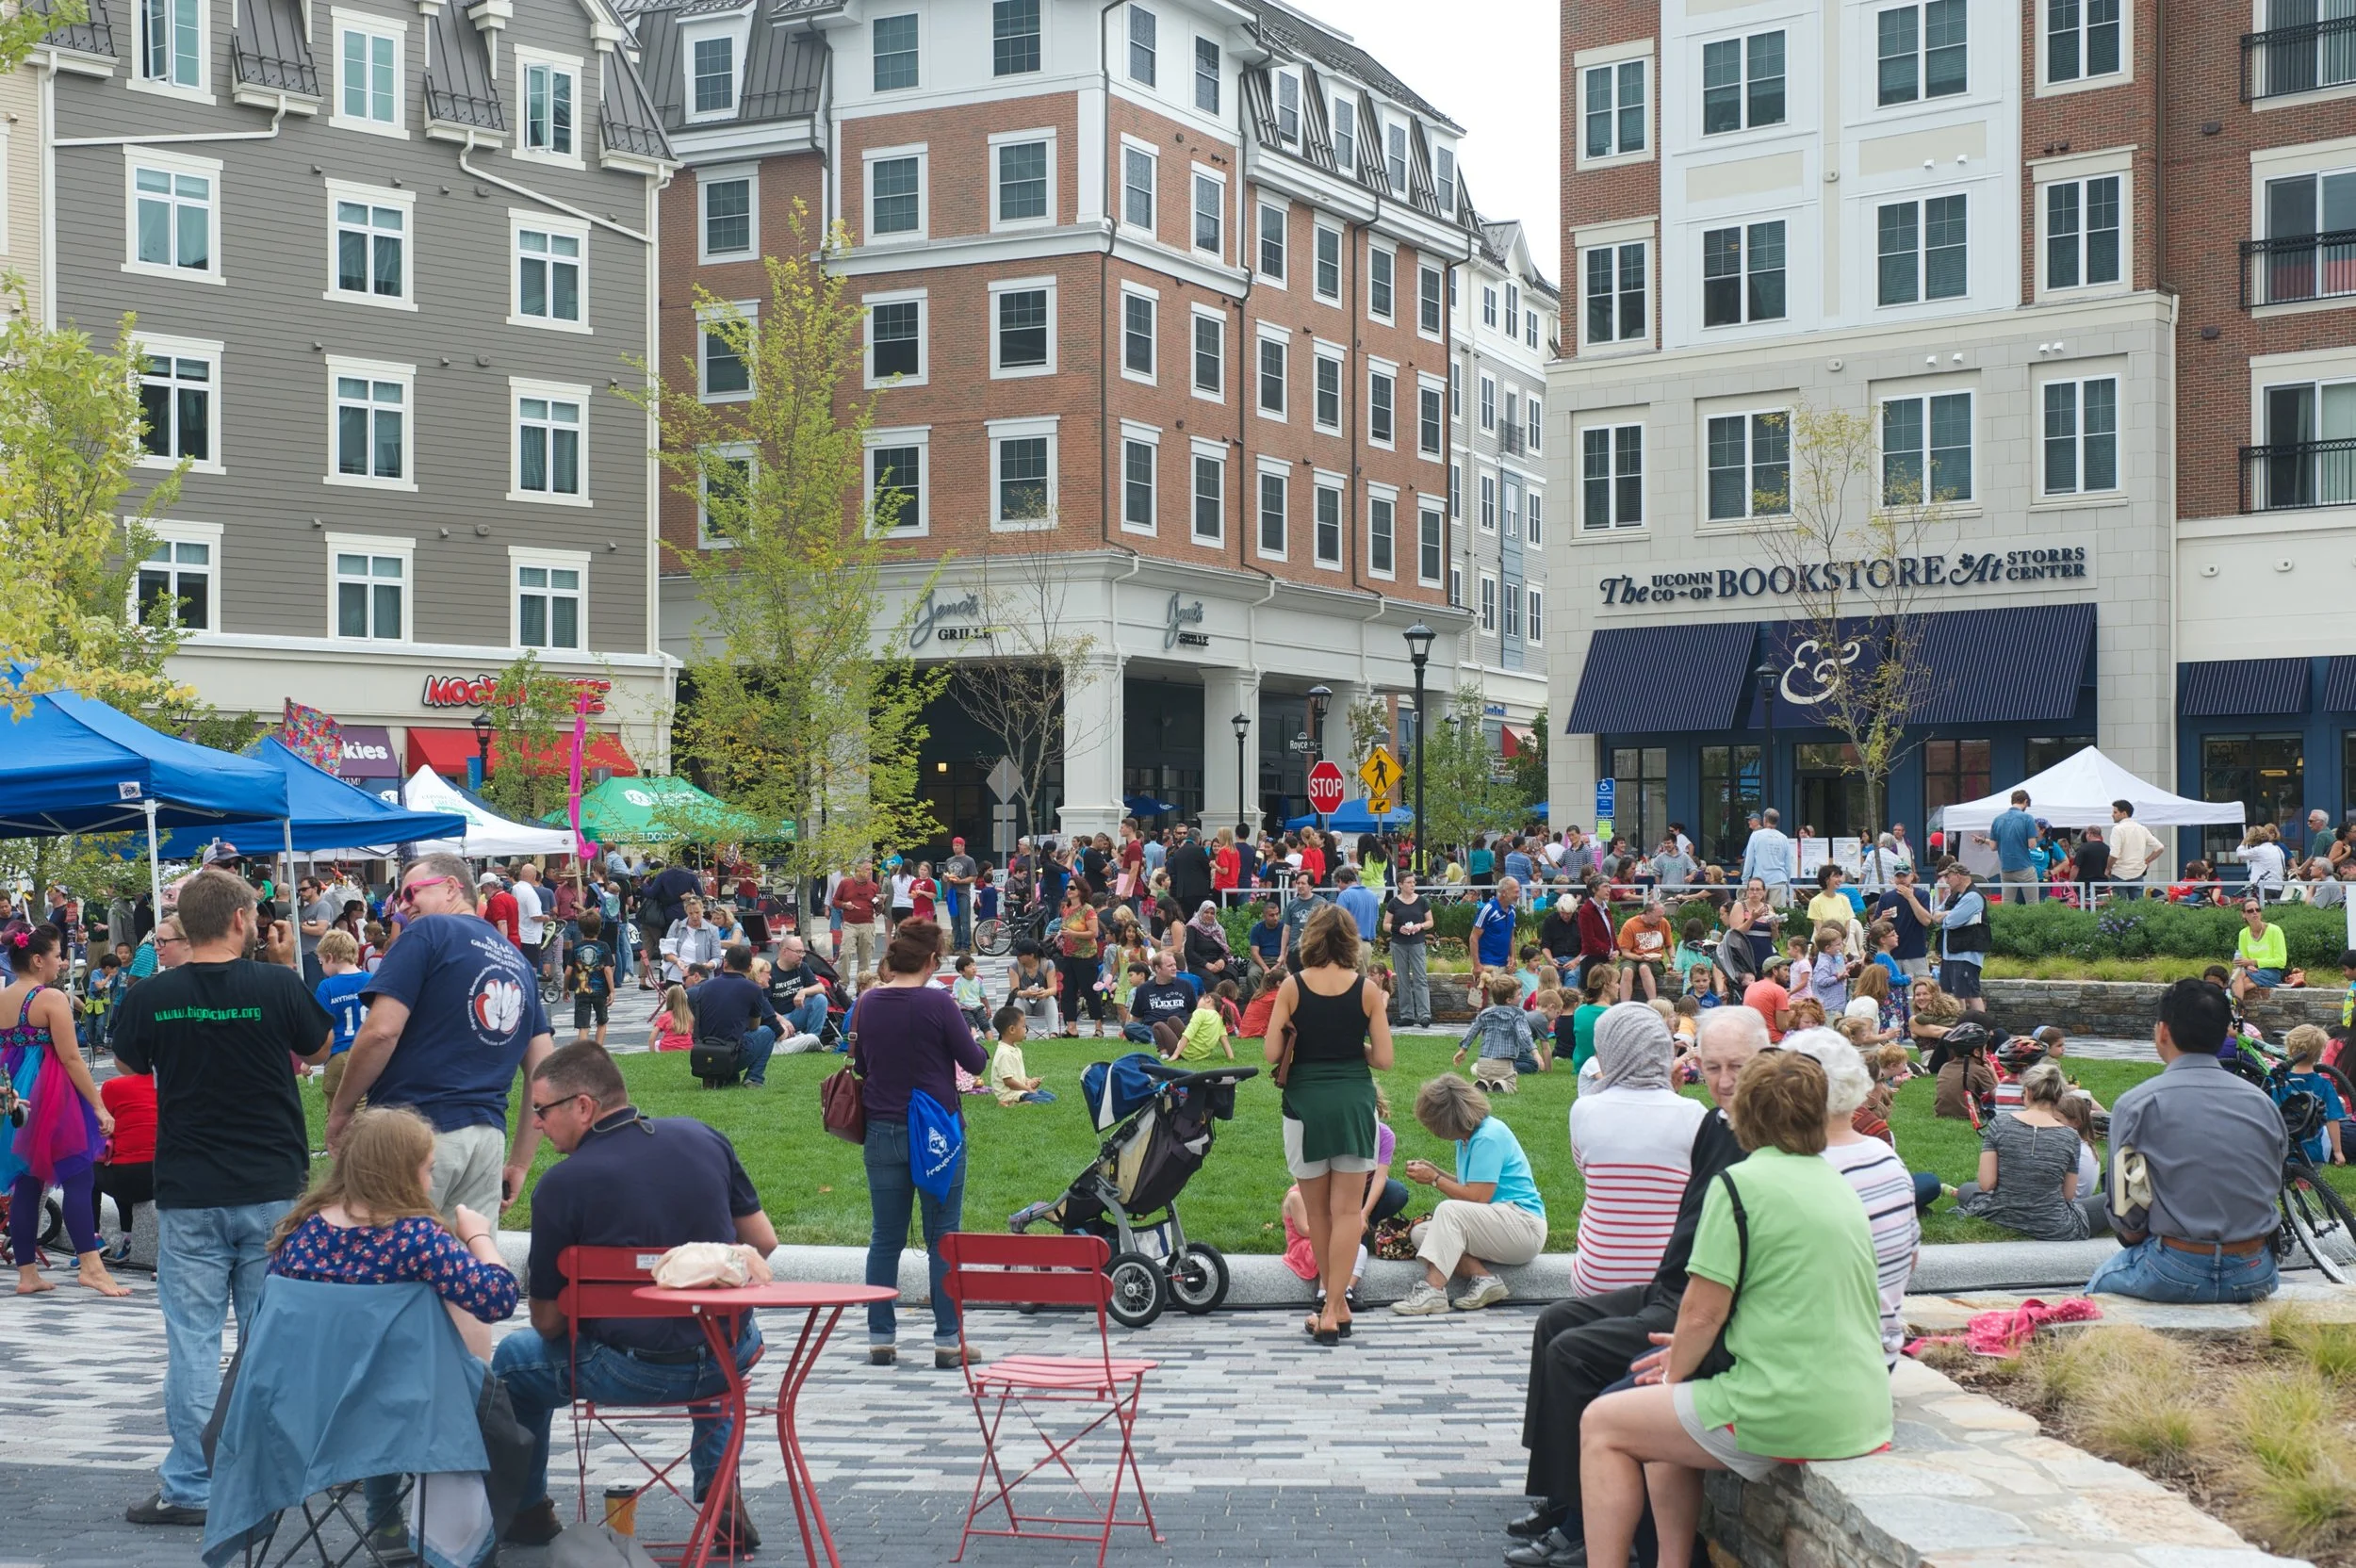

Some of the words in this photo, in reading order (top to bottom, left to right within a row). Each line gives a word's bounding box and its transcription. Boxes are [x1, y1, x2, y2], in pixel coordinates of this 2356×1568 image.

[2007, 547, 2086, 564] STORRS
[1716, 555, 1946, 597] BOOKSTORE
[1949, 553, 2004, 586] At
[2006, 564, 2086, 580] CENTER
[1651, 572, 1713, 587] UCONN
[1600, 575, 1649, 604] The
[1178, 632, 1209, 646] GRILLE
[1290, 740, 1308, 752] Royce
[1311, 777, 1343, 798] STOP
[1150, 999, 1185, 1009] FLEXER
